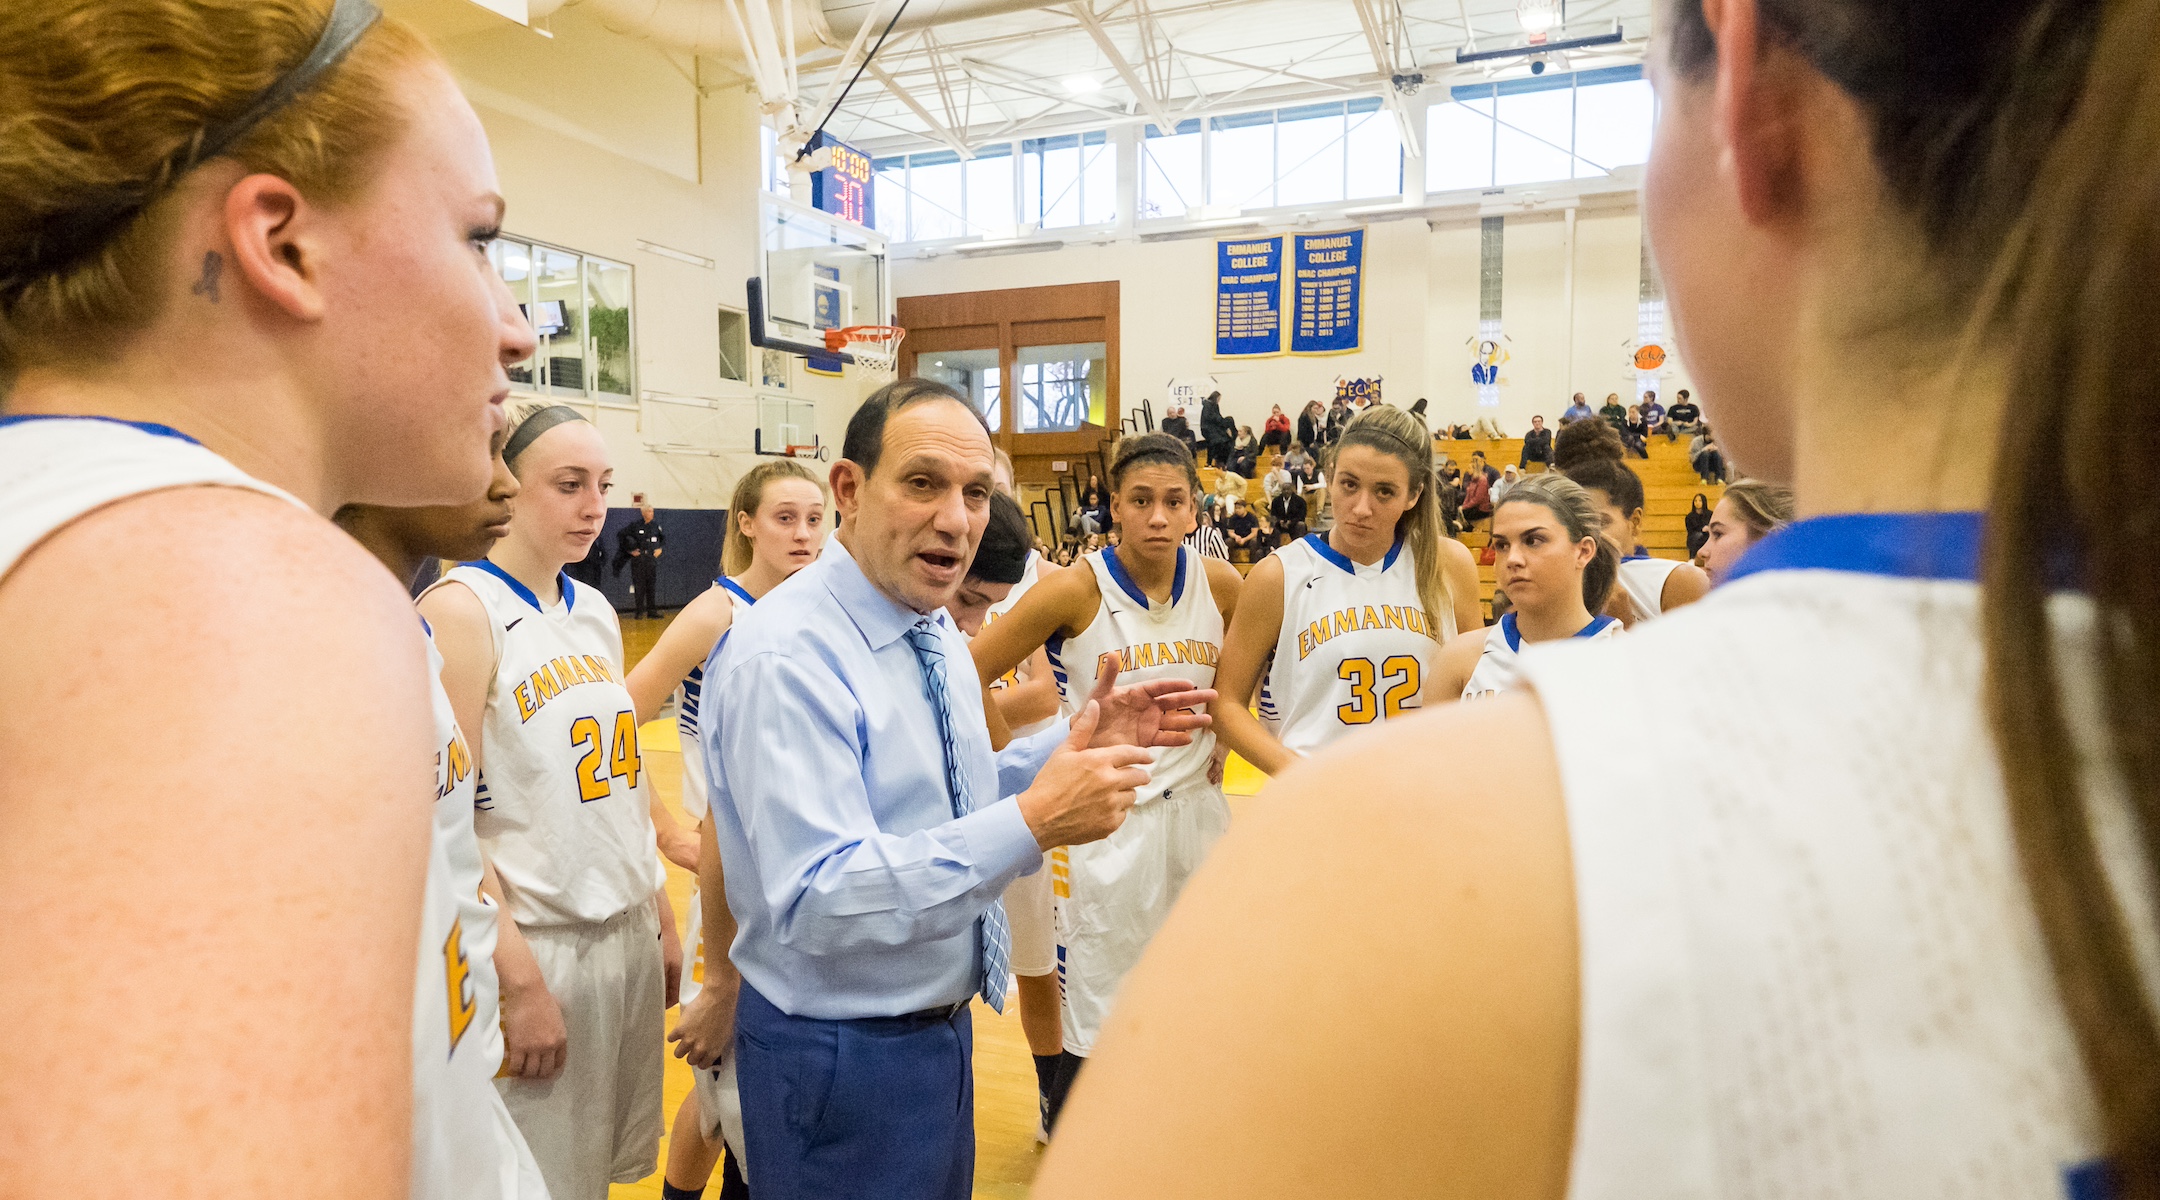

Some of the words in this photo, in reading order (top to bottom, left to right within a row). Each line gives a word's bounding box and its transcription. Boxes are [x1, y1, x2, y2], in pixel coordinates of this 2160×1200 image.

[832, 146, 870, 184] 10:00
[834, 174, 864, 225] 30
[1227, 242, 1273, 256] EMMANUEL
[1304, 236, 1352, 250] EMMANUEL
[1231, 256, 1268, 269] COLLEGE
[1309, 250, 1347, 264] COLLEGE
[1240, 273, 1277, 284] CHAMPIONS
[1317, 265, 1356, 278] CHAMPIONS
[1336, 319, 1350, 327] 2011
[1174, 386, 1194, 396] LETS
[1298, 604, 1442, 662] EMMANUE
[1337, 655, 1422, 725] 32
[570, 710, 641, 803] 24
